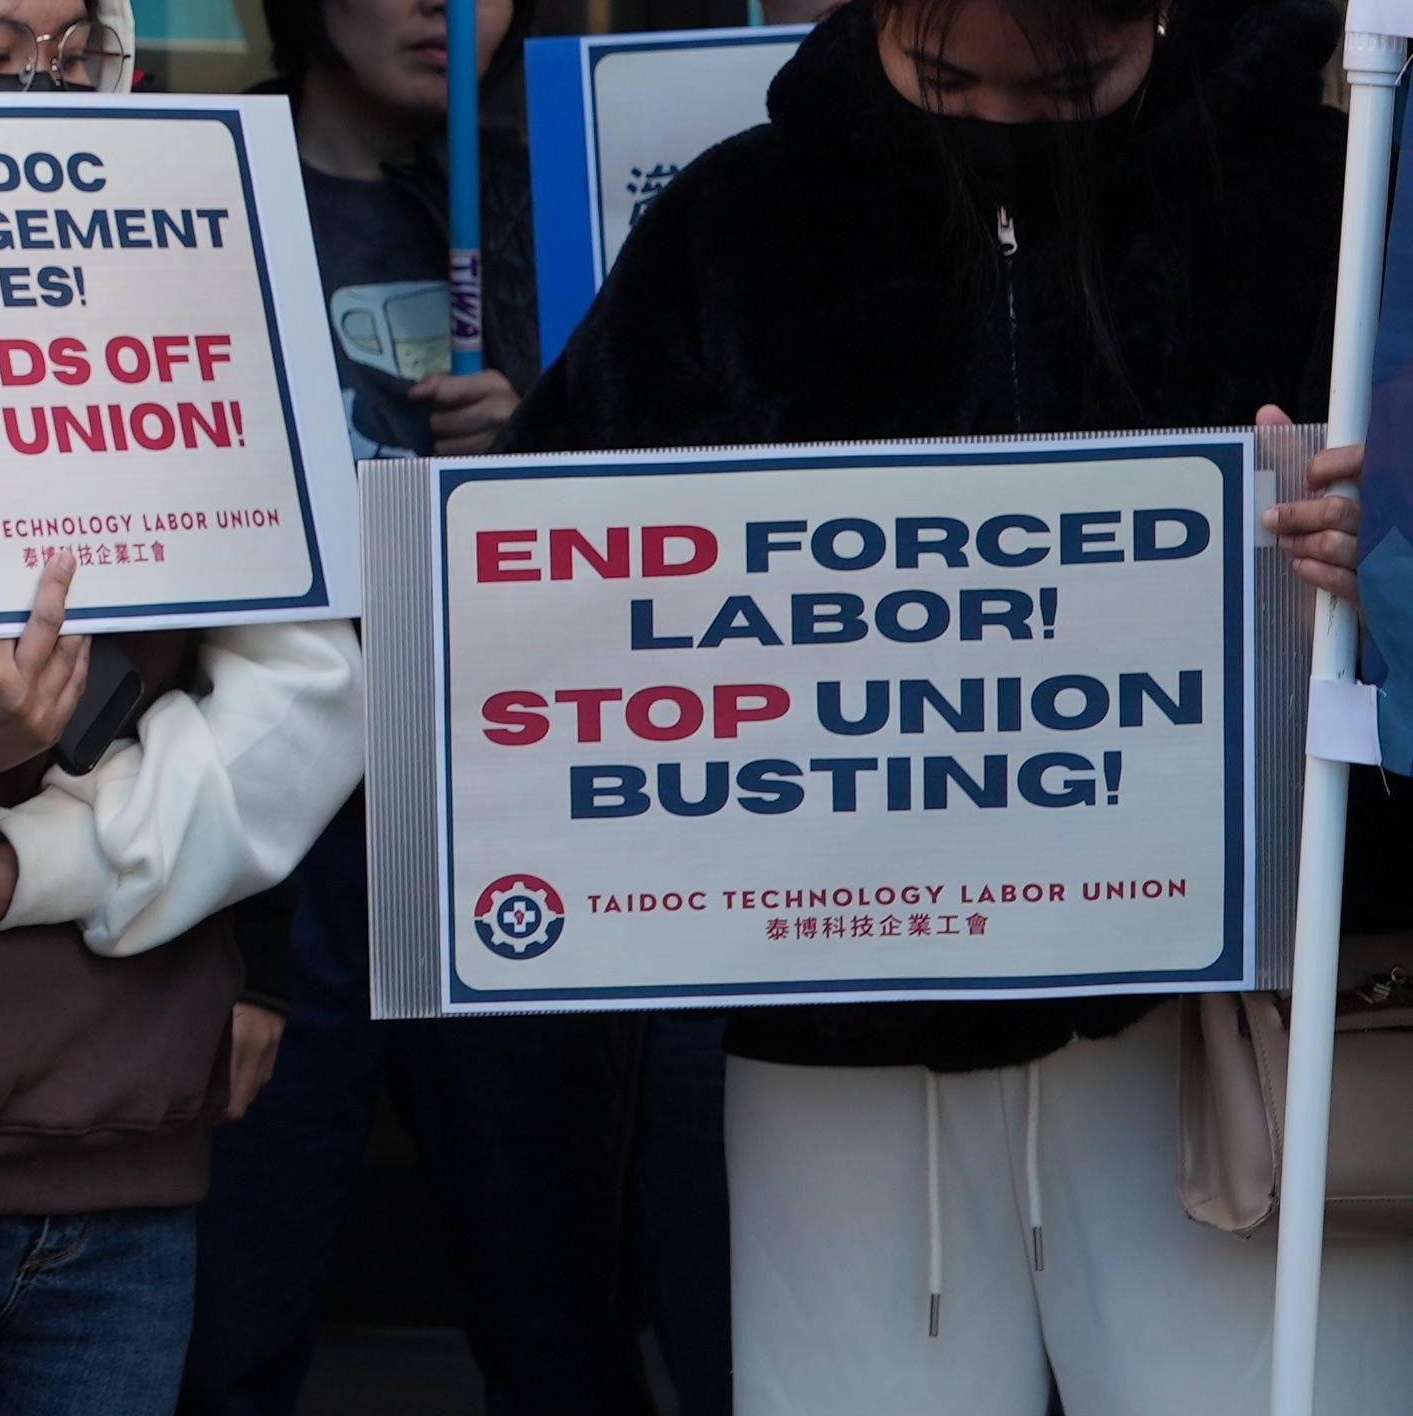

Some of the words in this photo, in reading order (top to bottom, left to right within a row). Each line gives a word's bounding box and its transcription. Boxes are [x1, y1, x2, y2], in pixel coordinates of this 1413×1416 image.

[105, 335, 231, 384] OFF
[2, 401, 245, 455] UNION!
[143, 512, 207, 531] LABOR
[217, 509, 279, 528] UNION
[476, 525, 718, 583] END
[746, 508, 1210, 573] FORCED
[24, 541, 164, 568] 泰博技企業工會
[631, 587, 1057, 650] LABOR!
[482, 684, 790, 746] STOP
[817, 670, 1202, 736] UNION
[570, 751, 1122, 819] BUSTING!
[588, 892, 706, 913] TAIDOC
[723, 885, 944, 909] TECHNOLOGY
[962, 884, 1064, 903] LABOR
[1083, 879, 1185, 901] UNION
[767, 913, 988, 940] 泰博科技企業工會
